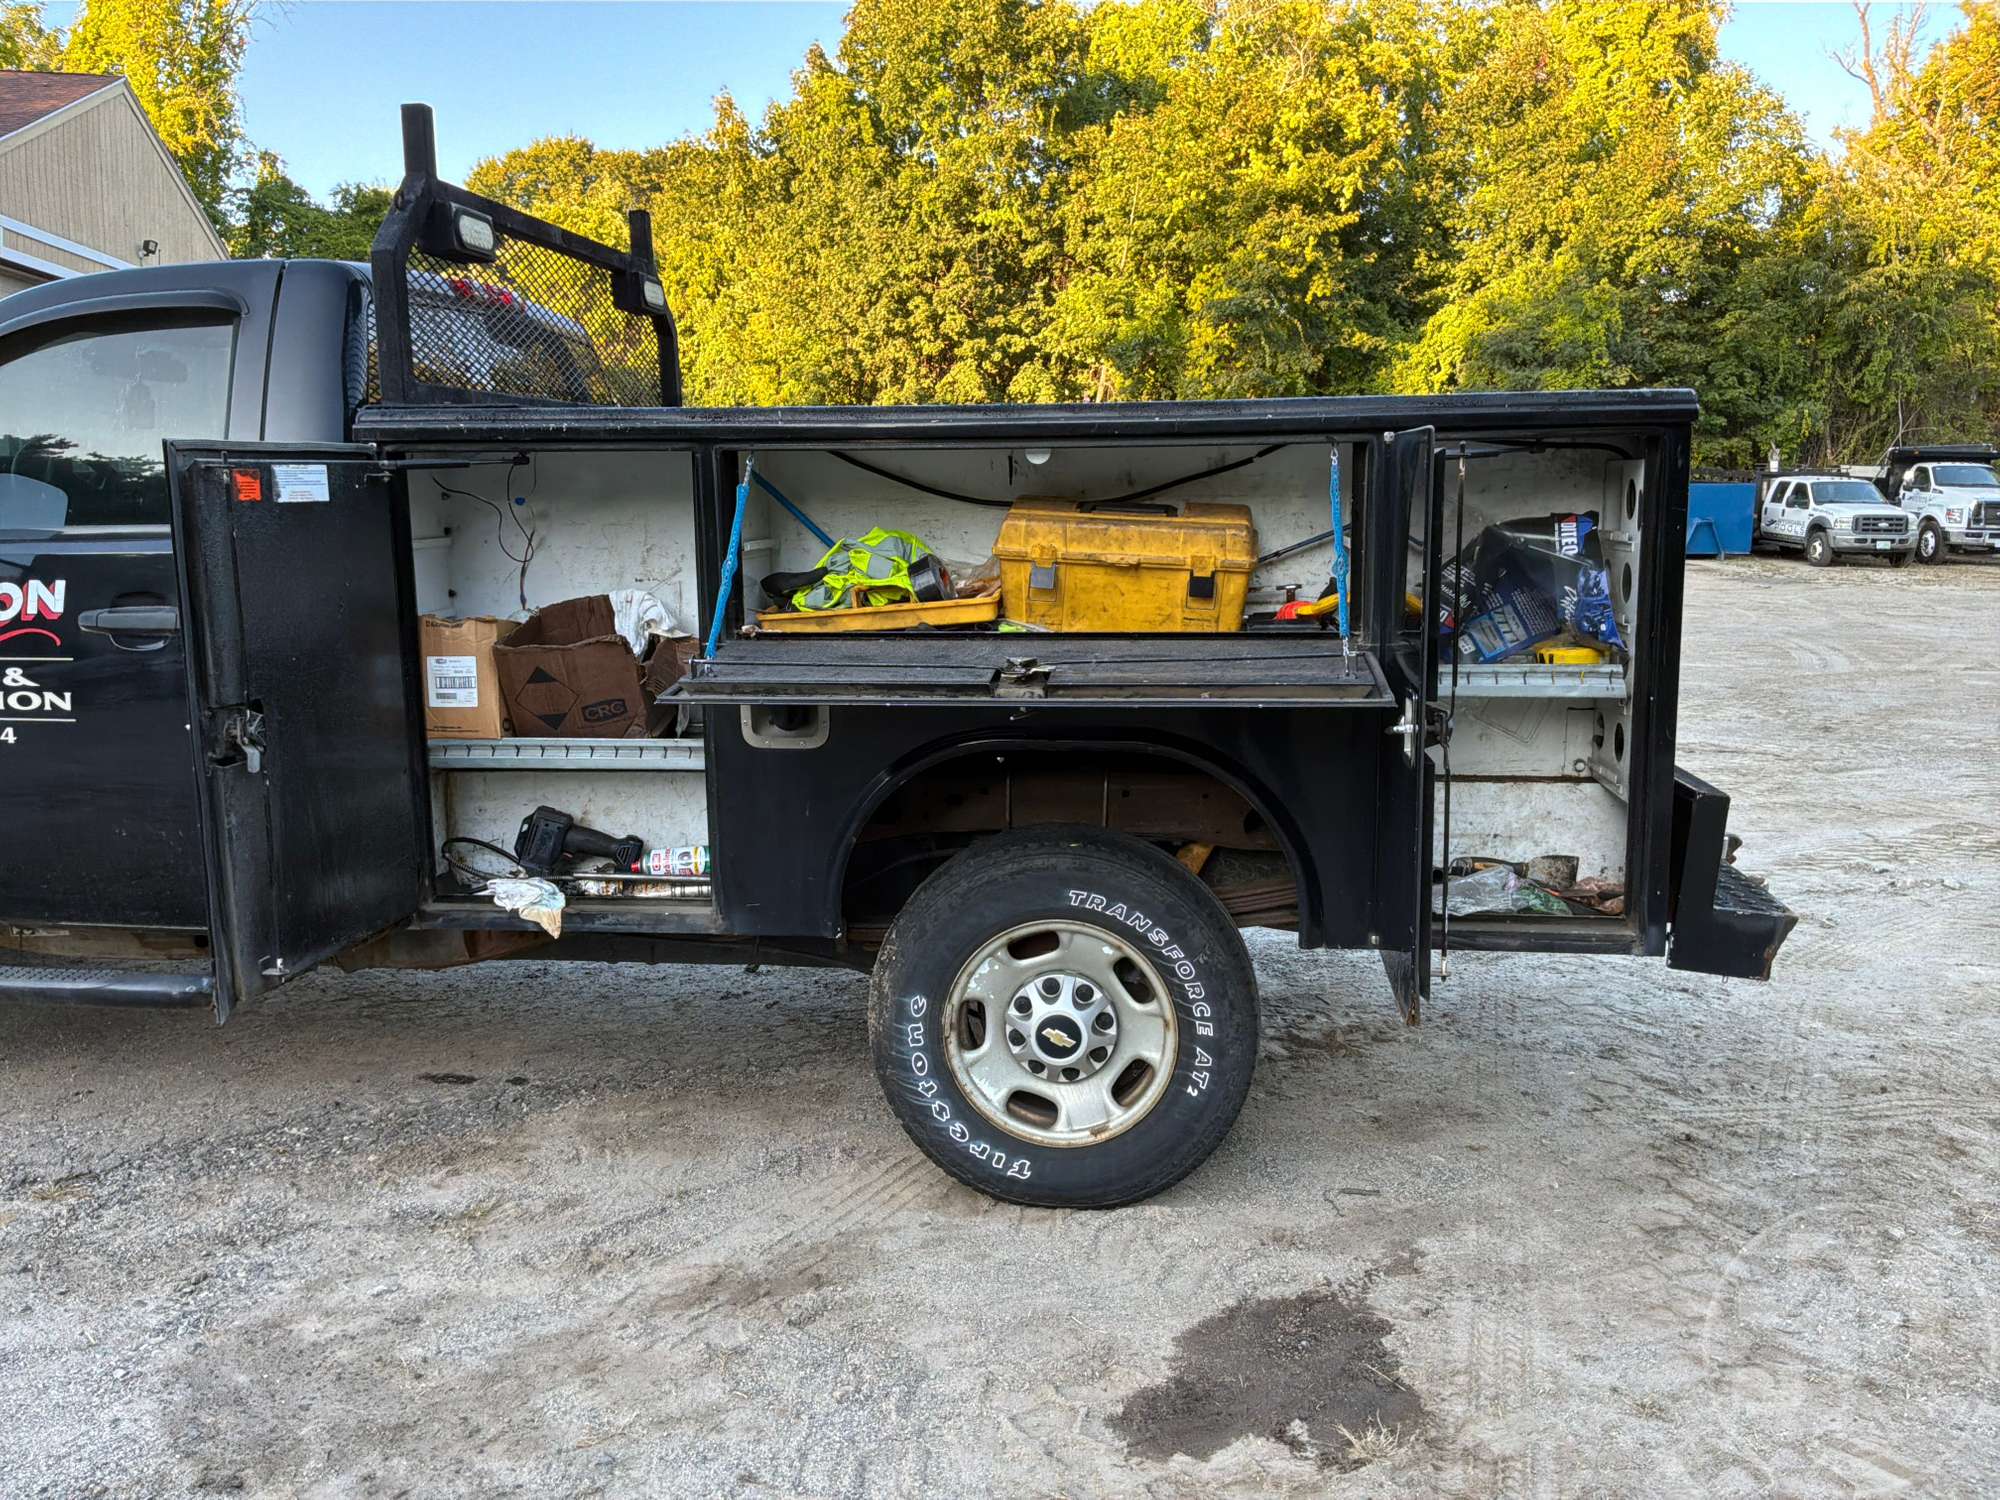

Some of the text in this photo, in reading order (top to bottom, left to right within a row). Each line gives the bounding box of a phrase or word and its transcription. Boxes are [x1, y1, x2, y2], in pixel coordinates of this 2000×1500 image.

[2, 667, 41, 687] &
[584, 701, 624, 719] CRC
[0, 727, 17, 743] 4
[1068, 889, 1213, 1037] TRANSFORCE
[907, 994, 1032, 1180] Firestone
